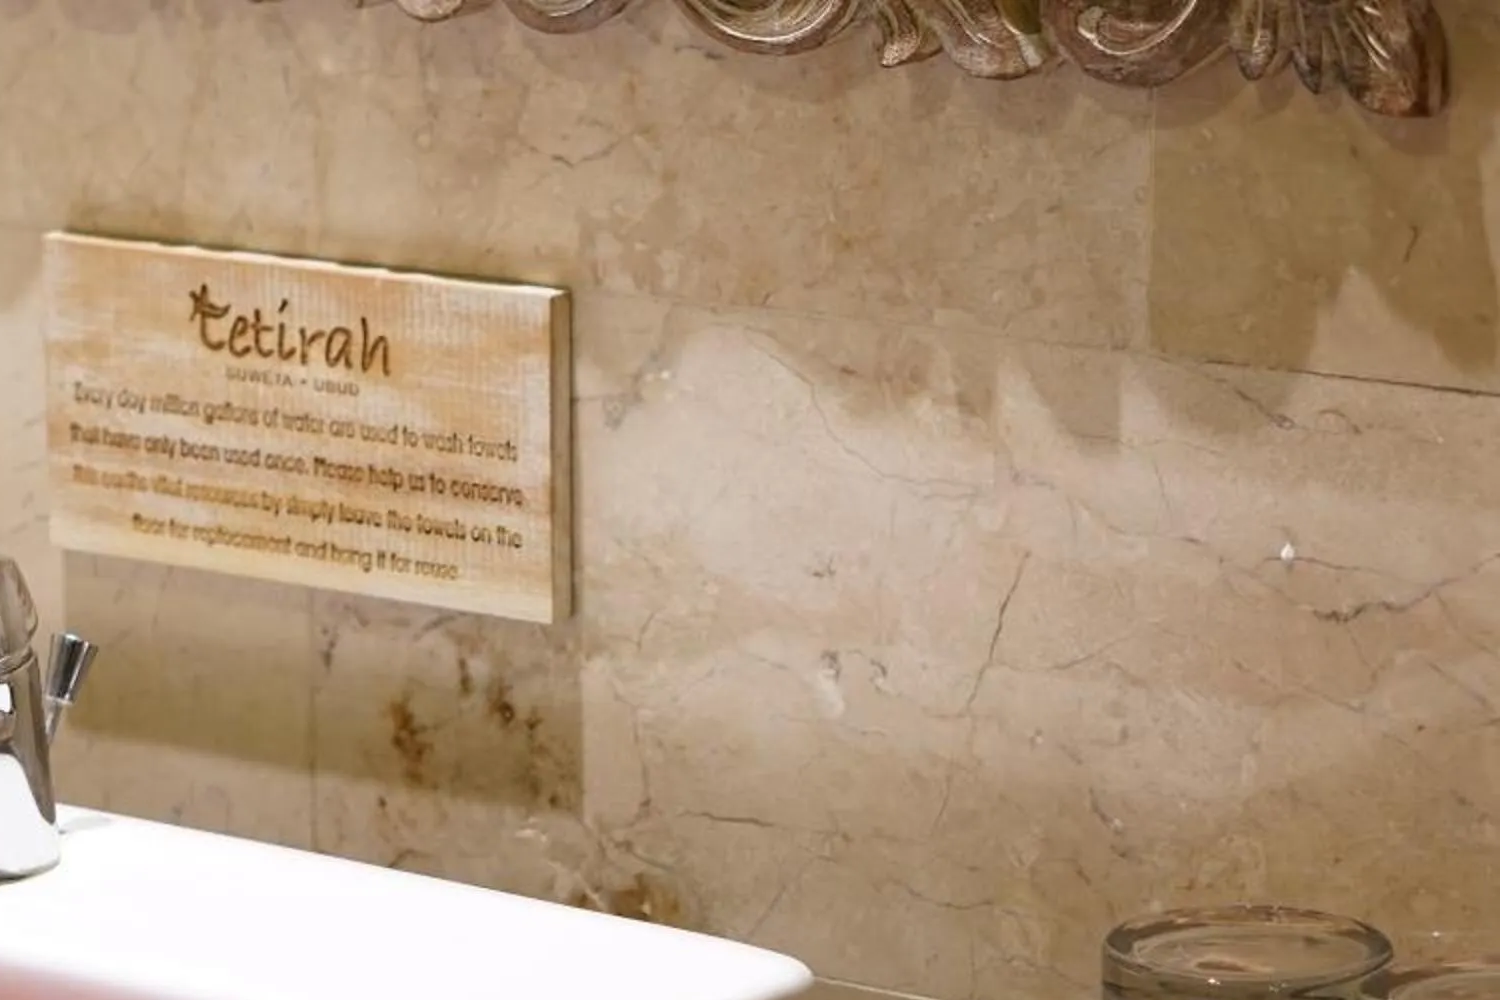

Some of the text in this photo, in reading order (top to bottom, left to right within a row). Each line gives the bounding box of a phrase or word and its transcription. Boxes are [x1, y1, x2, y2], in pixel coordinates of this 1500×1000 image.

[189, 283, 391, 377] tetirah
[262, 407, 280, 428] of
[360, 424, 399, 445] used
[402, 425, 420, 448] to
[421, 431, 464, 454] wash
[467, 434, 518, 462] towels
[179, 438, 221, 462] been
[223, 447, 262, 468] used
[313, 456, 364, 483] Please
[368, 463, 404, 492] help
[408, 473, 426, 492] us
[429, 472, 447, 495] to
[450, 478, 524, 507] conserve
[387, 509, 412, 532] the
[416, 513, 467, 541] towels
[471, 526, 492, 544] on
[496, 524, 523, 549] the
[294, 541, 327, 562] and
[330, 543, 373, 573] hang
[390, 551, 411, 574] for
